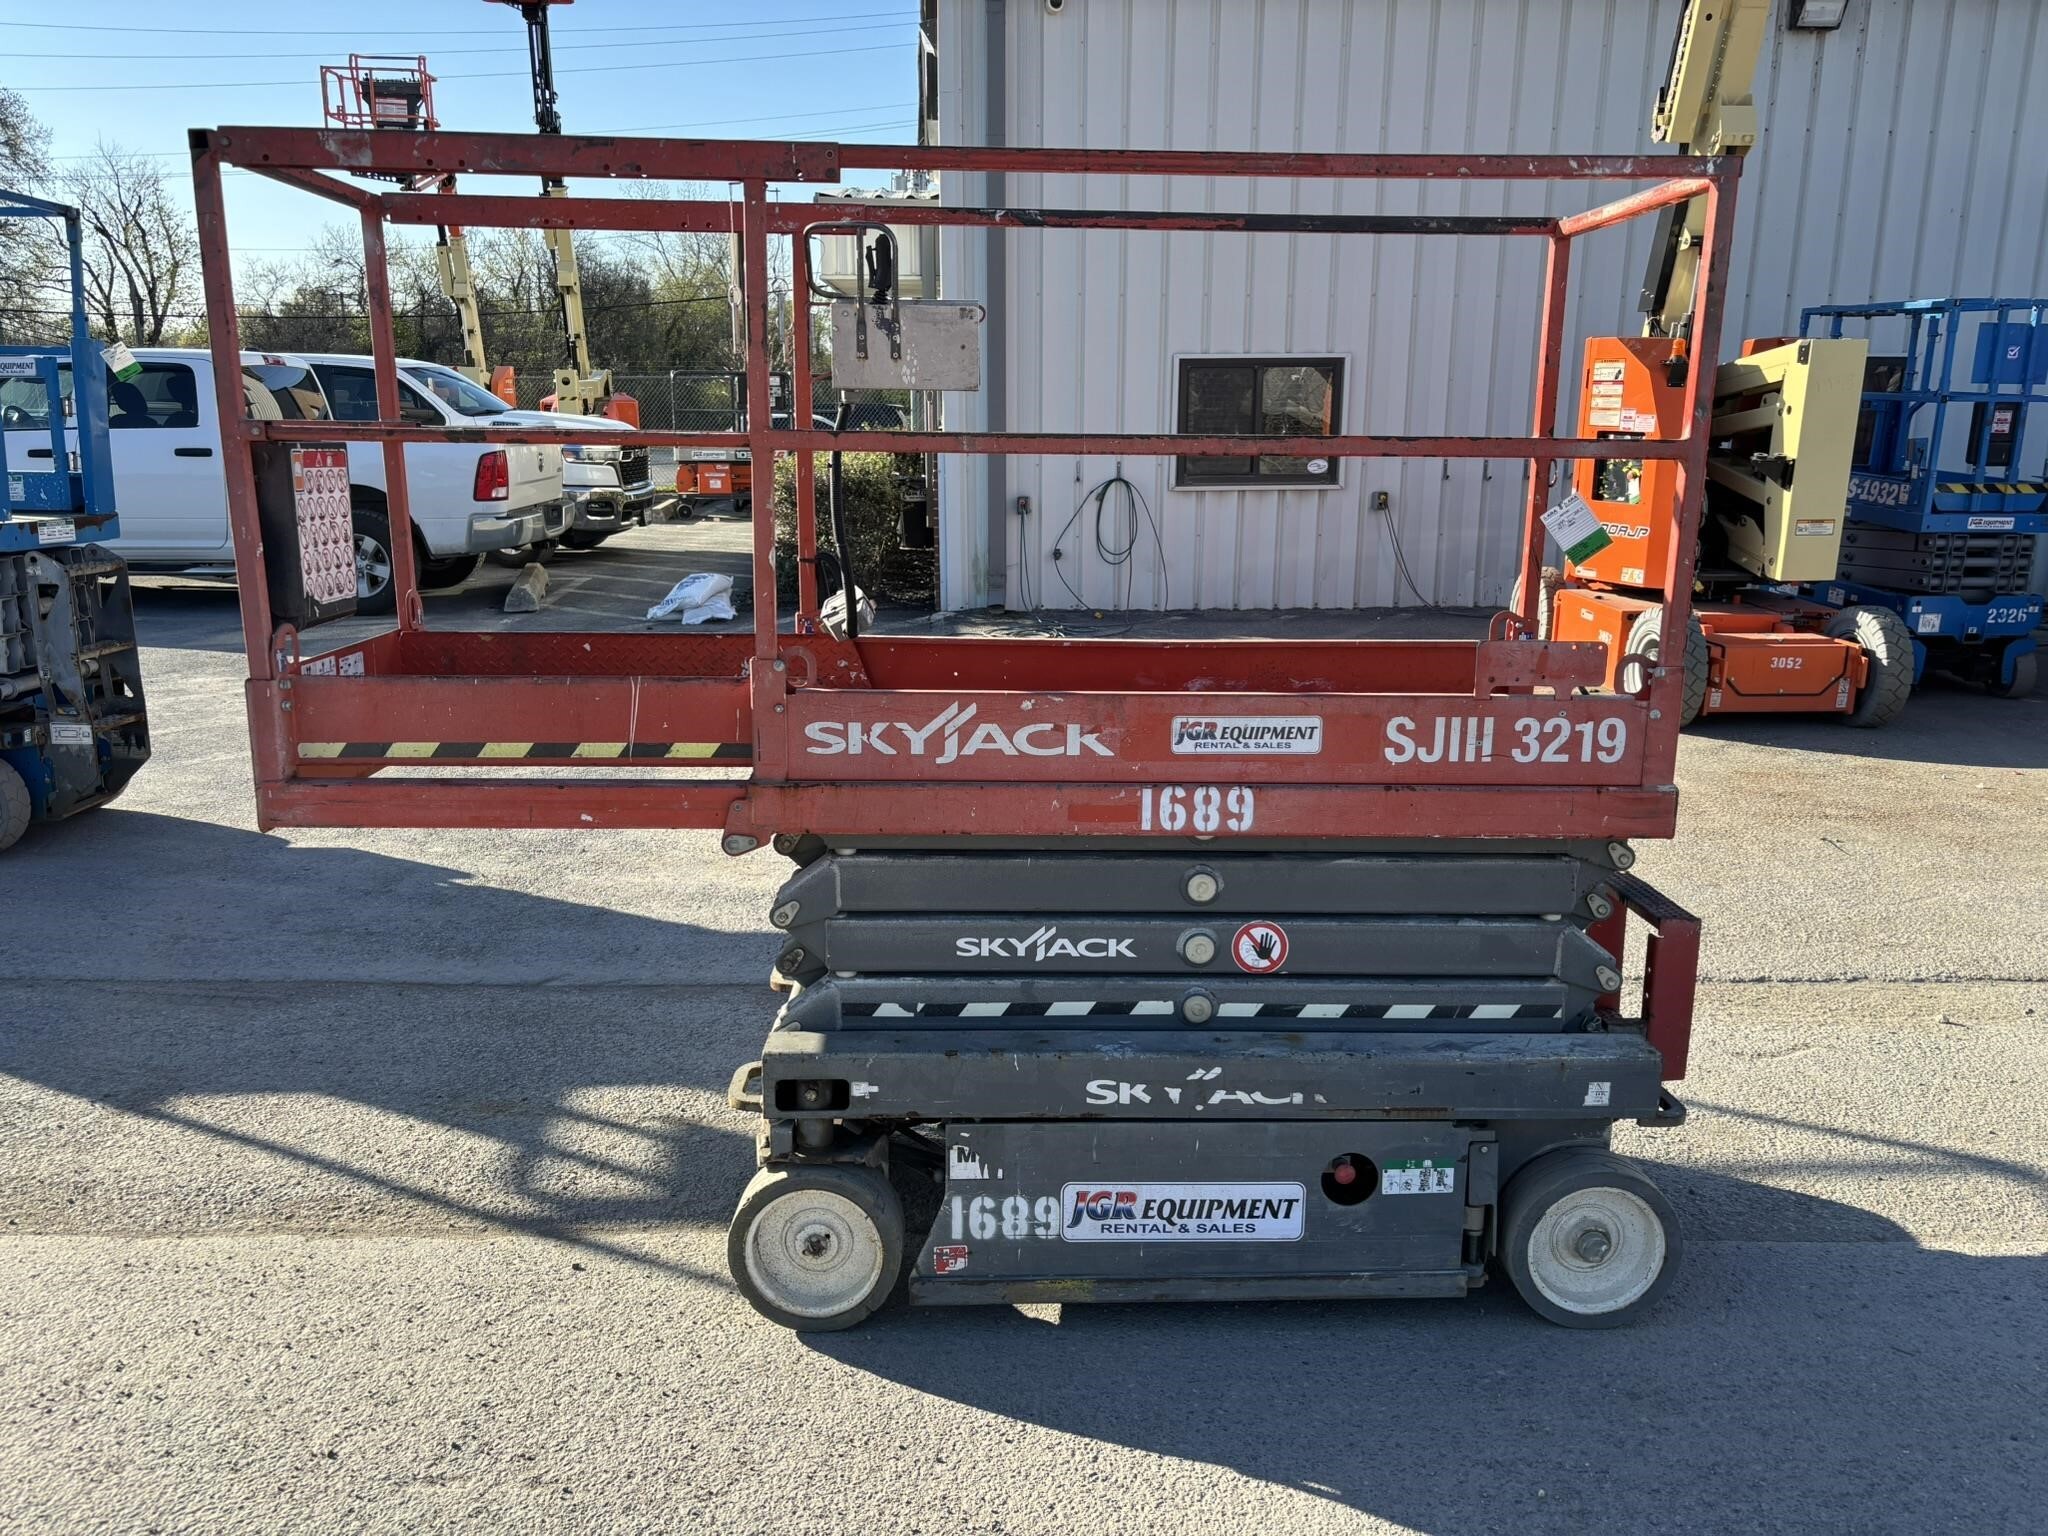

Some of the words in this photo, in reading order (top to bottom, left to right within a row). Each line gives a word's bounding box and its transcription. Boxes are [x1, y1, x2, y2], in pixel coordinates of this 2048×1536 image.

[1986, 607, 2028, 623] 2326
[1770, 656, 1802, 669] 3052
[805, 701, 1115, 764] SKYJACK
[1174, 721, 1218, 746] JGR
[1220, 726, 1318, 744] EQUIPMENT
[1512, 717, 1627, 763] 3219
[1141, 785, 1254, 832] 1689
[955, 924, 1138, 962] SKYJACK
[951, 1195, 1060, 1240] 1689
[1067, 1190, 1138, 1228] JGR
[1141, 1198, 1300, 1227] EQUIPMENT
[1100, 1223, 1173, 1234] RENTAL
[1178, 1223, 1190, 1234] &
[1196, 1223, 1256, 1234] SALES
